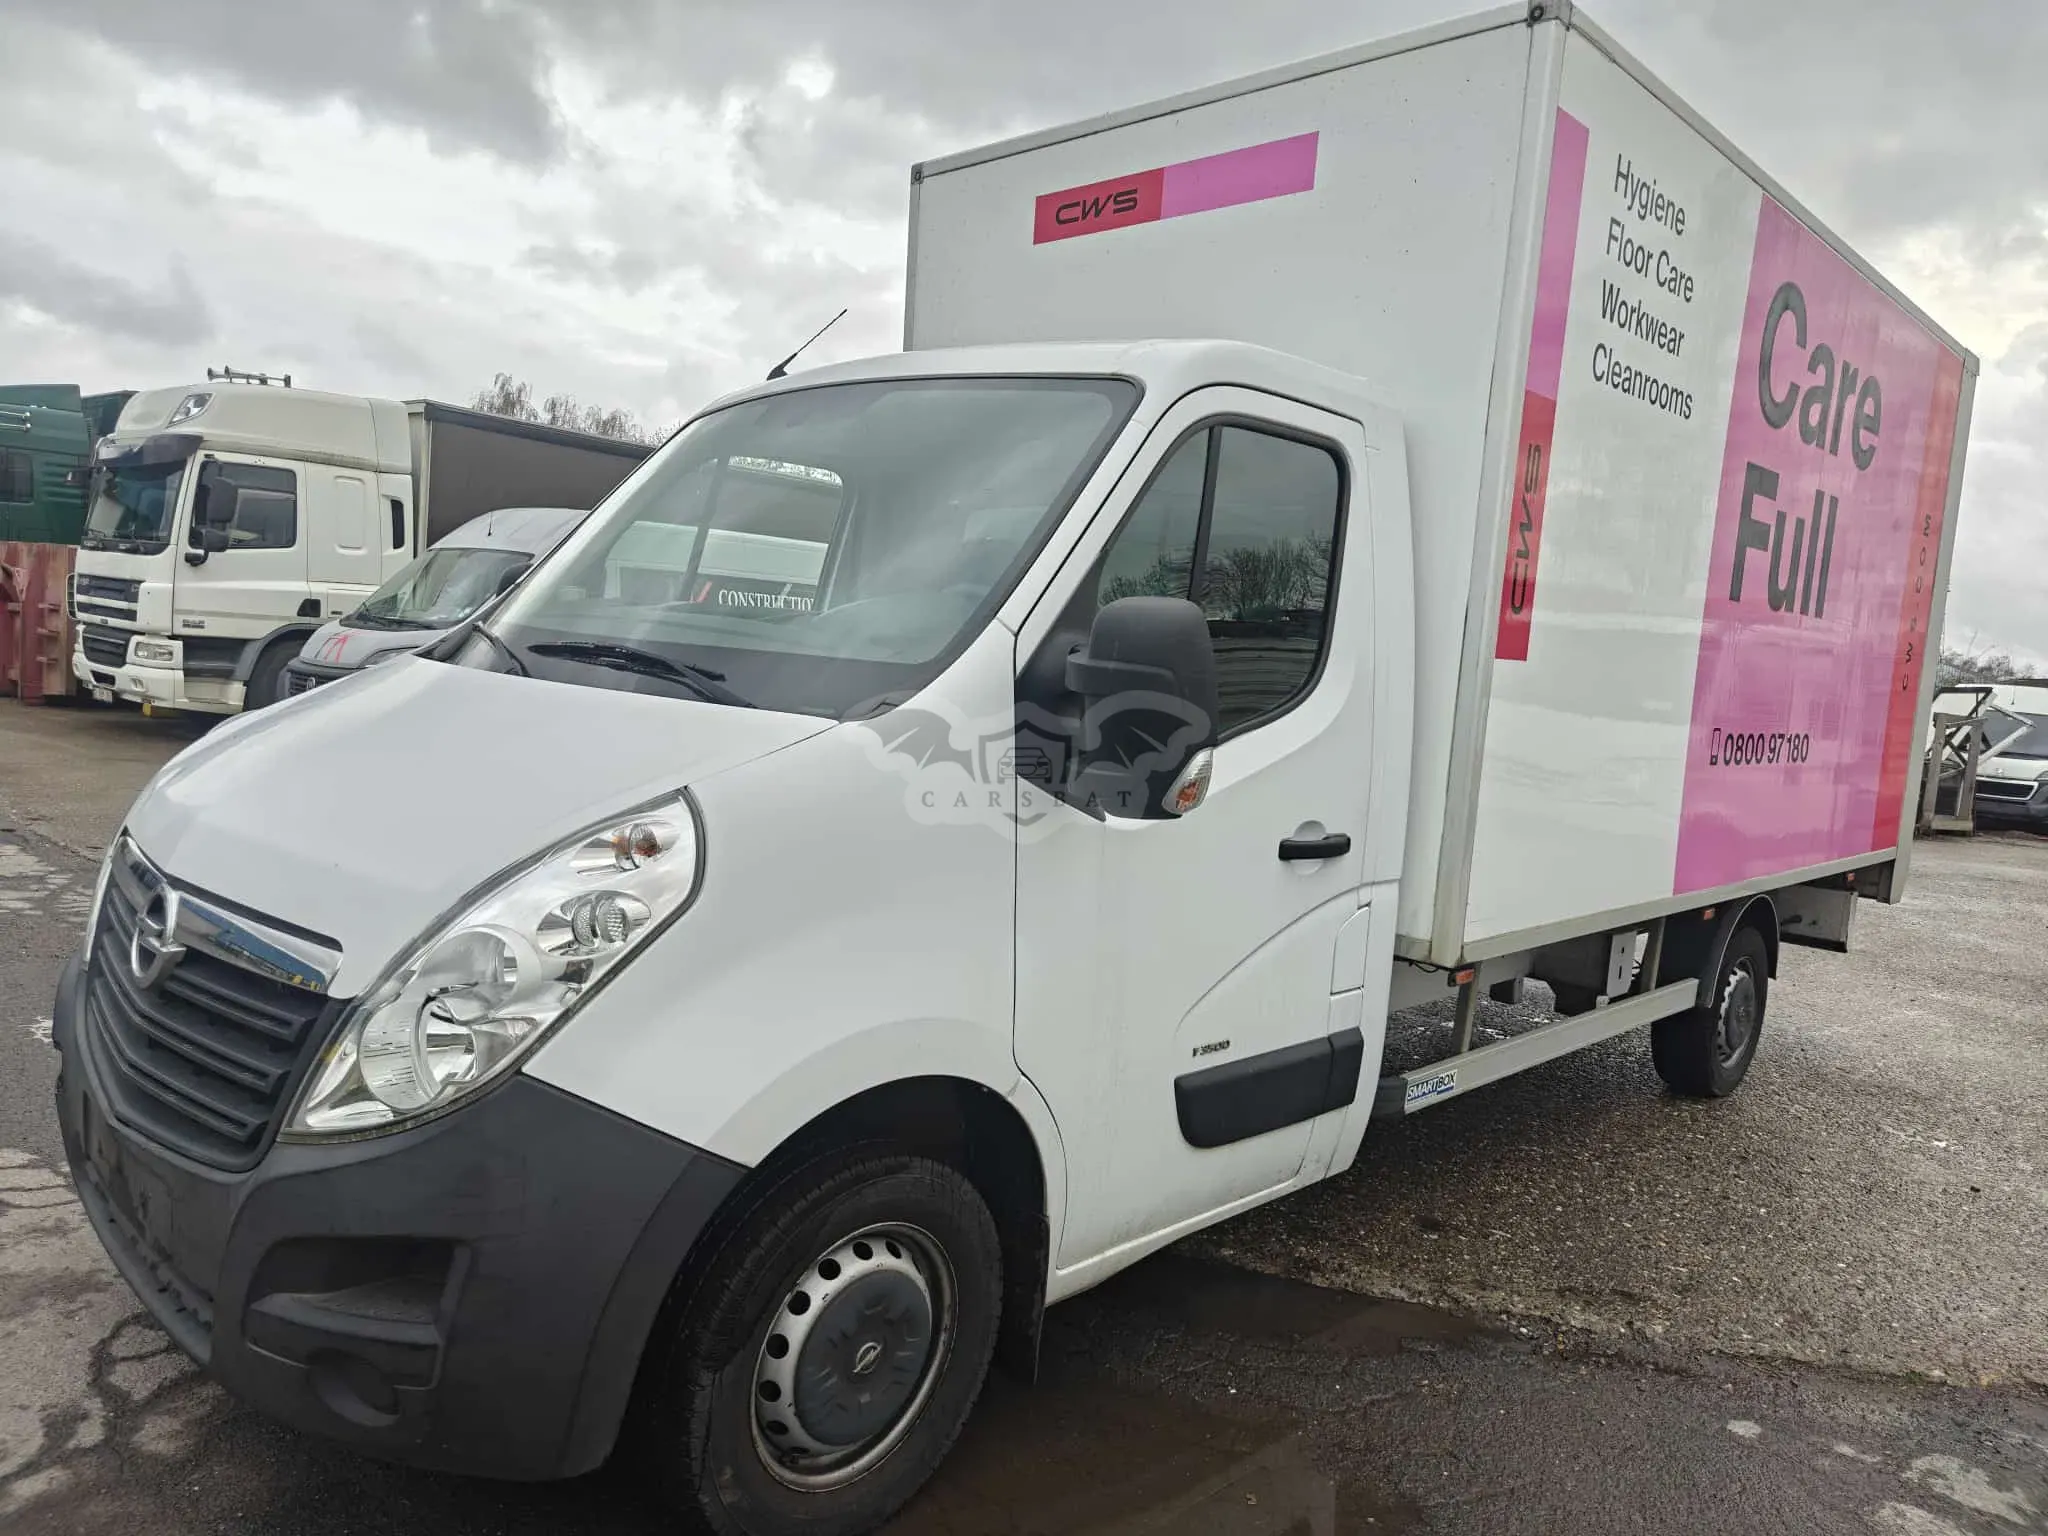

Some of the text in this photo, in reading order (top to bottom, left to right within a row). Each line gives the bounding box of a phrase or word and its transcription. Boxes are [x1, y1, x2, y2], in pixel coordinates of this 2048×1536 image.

[1055, 187, 1138, 226] CWS
[1614, 153, 1686, 236] Hygiene
[1606, 216, 1694, 303] Floor Care
[1600, 279, 1685, 357] Workwear
[1592, 343, 1693, 420] Cleanrooms
[1758, 281, 1883, 471] Care
[1511, 443, 1542, 615] CWS
[1728, 460, 1839, 619] Full
[1723, 733, 1810, 766] 0800 97180
[1407, 1071, 1457, 1100] SMARTBOX
